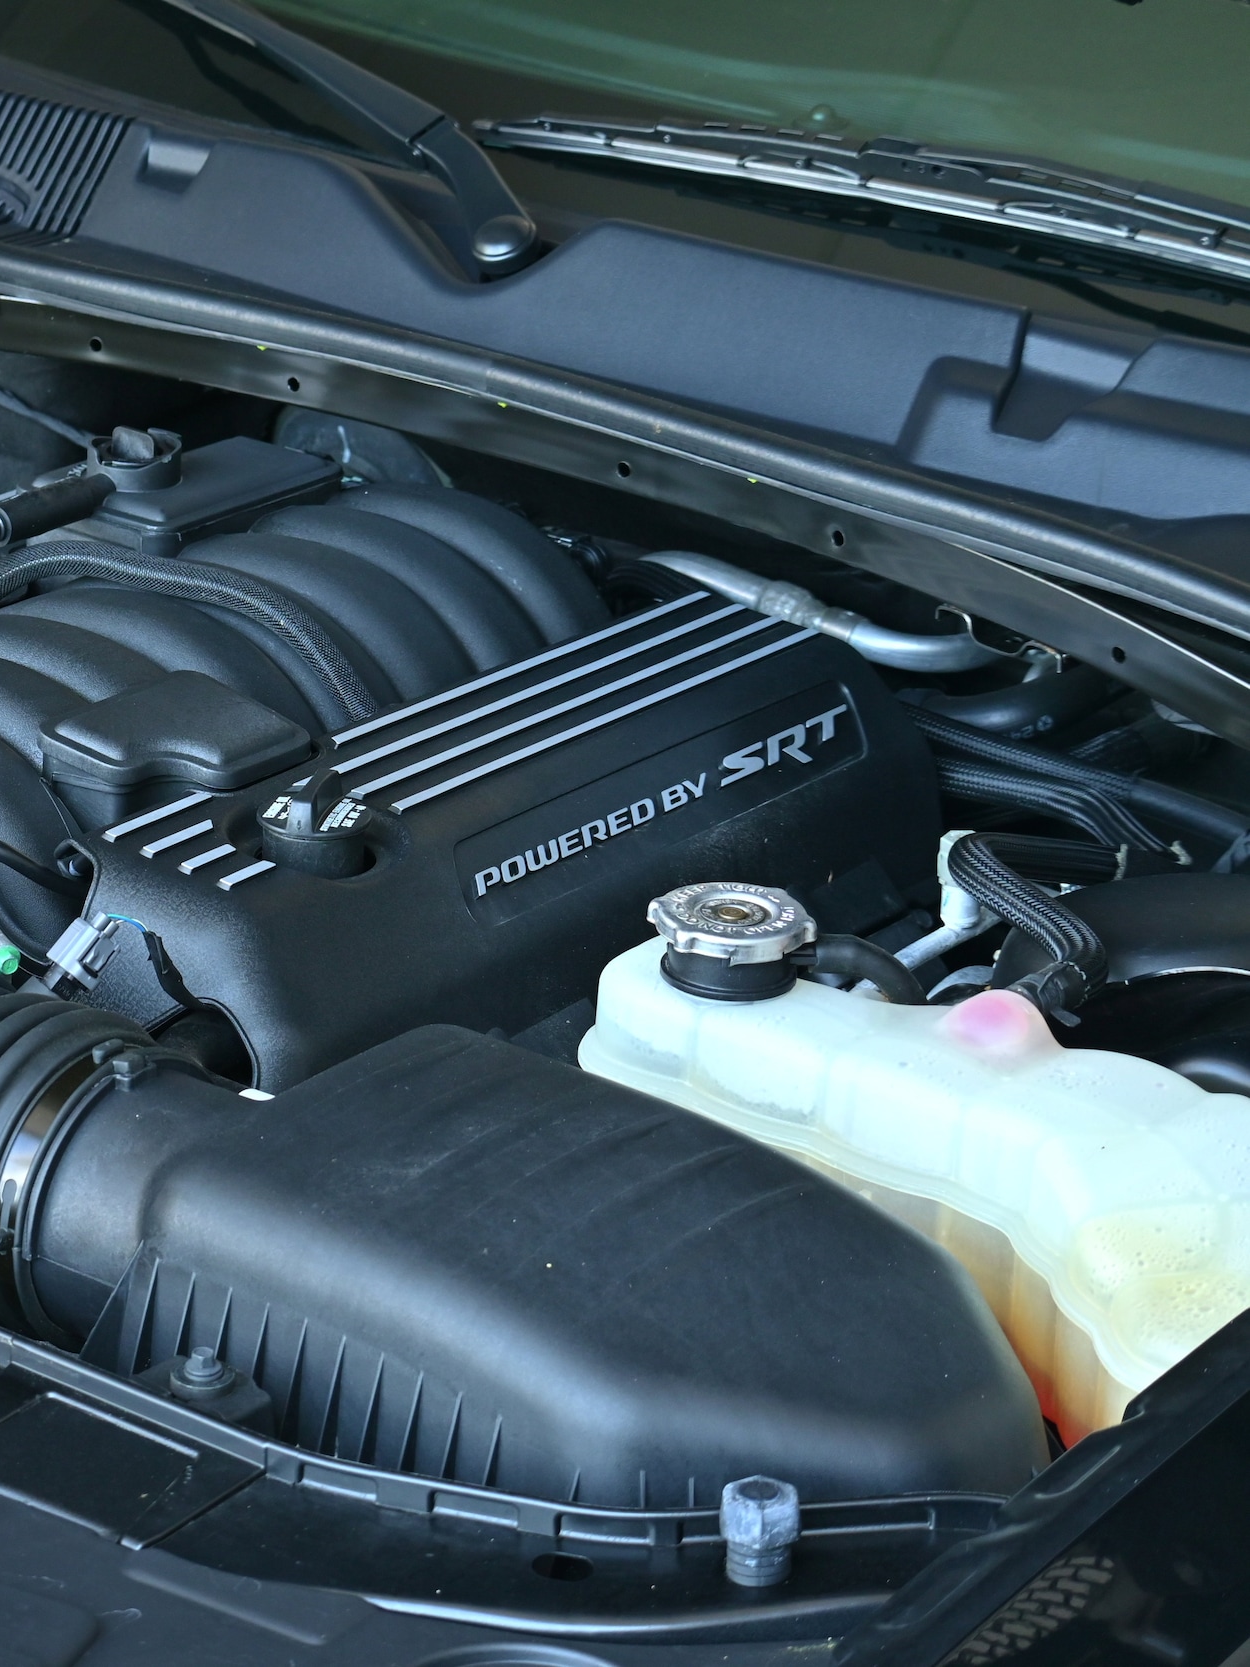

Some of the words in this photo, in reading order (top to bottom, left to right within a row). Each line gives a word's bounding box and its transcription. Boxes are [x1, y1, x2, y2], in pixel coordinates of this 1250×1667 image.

[473, 797, 656, 897] POWERED
[662, 772, 707, 813] BY
[719, 703, 847, 788] SRT
